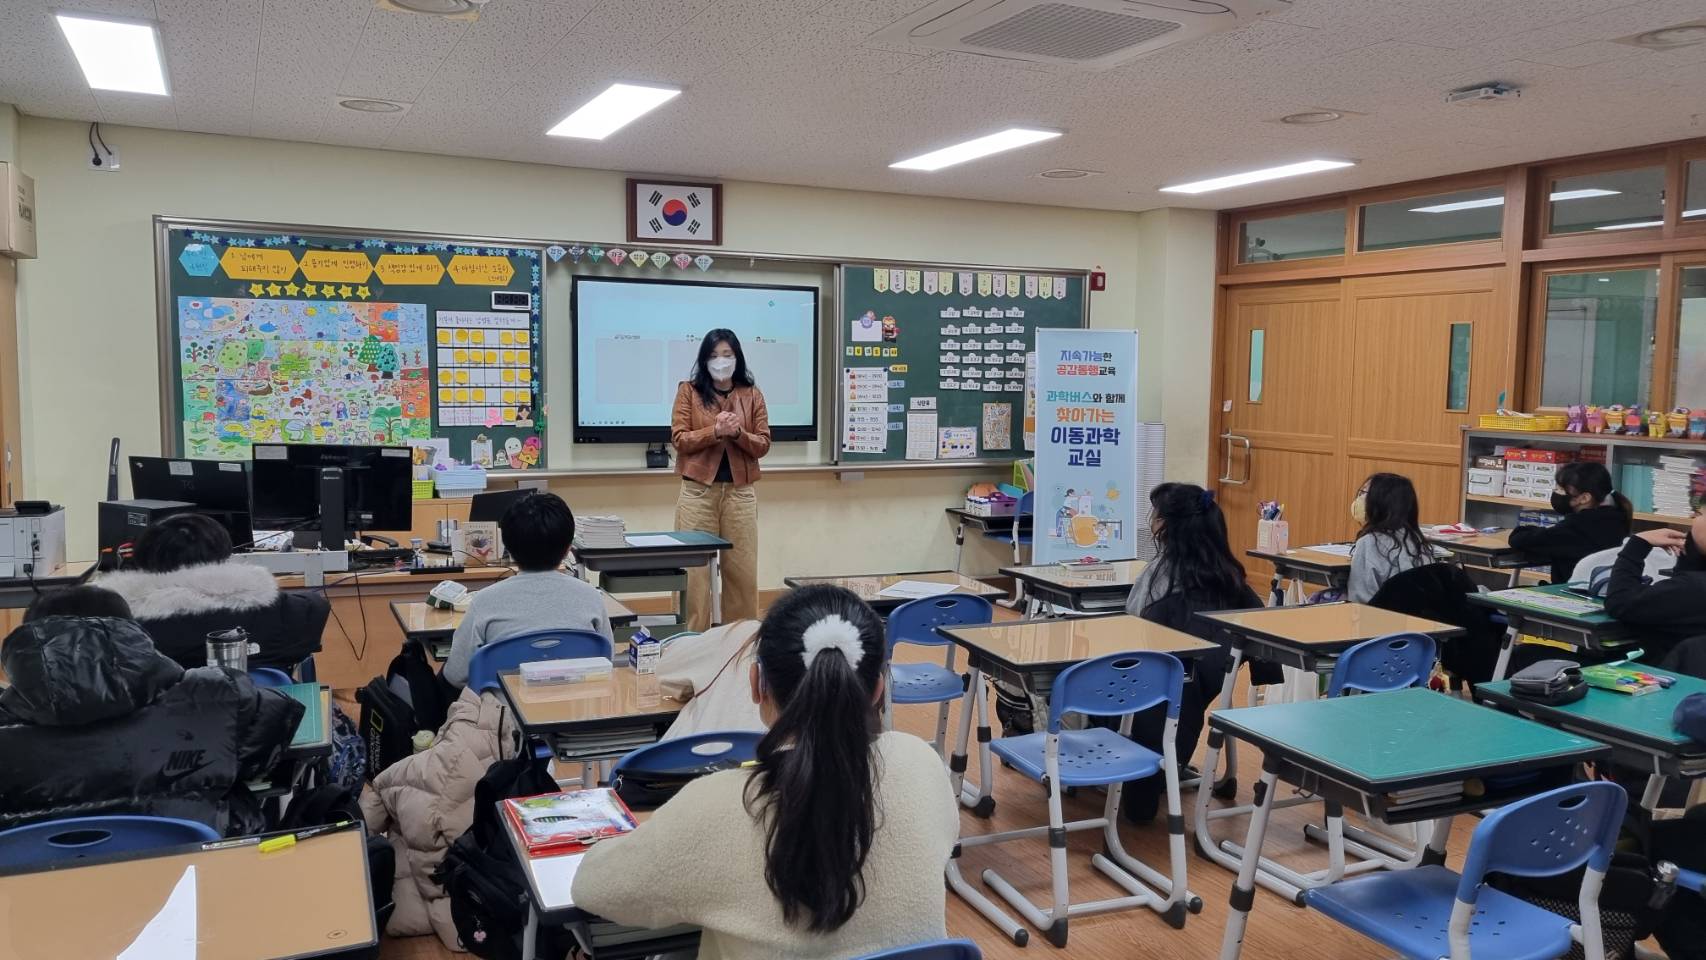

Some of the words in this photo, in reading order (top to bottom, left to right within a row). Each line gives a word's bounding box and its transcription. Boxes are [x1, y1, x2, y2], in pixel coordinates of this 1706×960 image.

[1060, 350, 1112, 362] 지속가능한
[1056, 364, 1116, 376] 공감동행교육
[1046, 390, 1103, 403] 과학버스와
[1105, 393, 1126, 404] 함께
[1056, 407, 1116, 423] 찾아가는
[1050, 426, 1121, 446] 이동과학
[1067, 449, 1102, 467] 교실
[166, 749, 207, 770] NIKE
